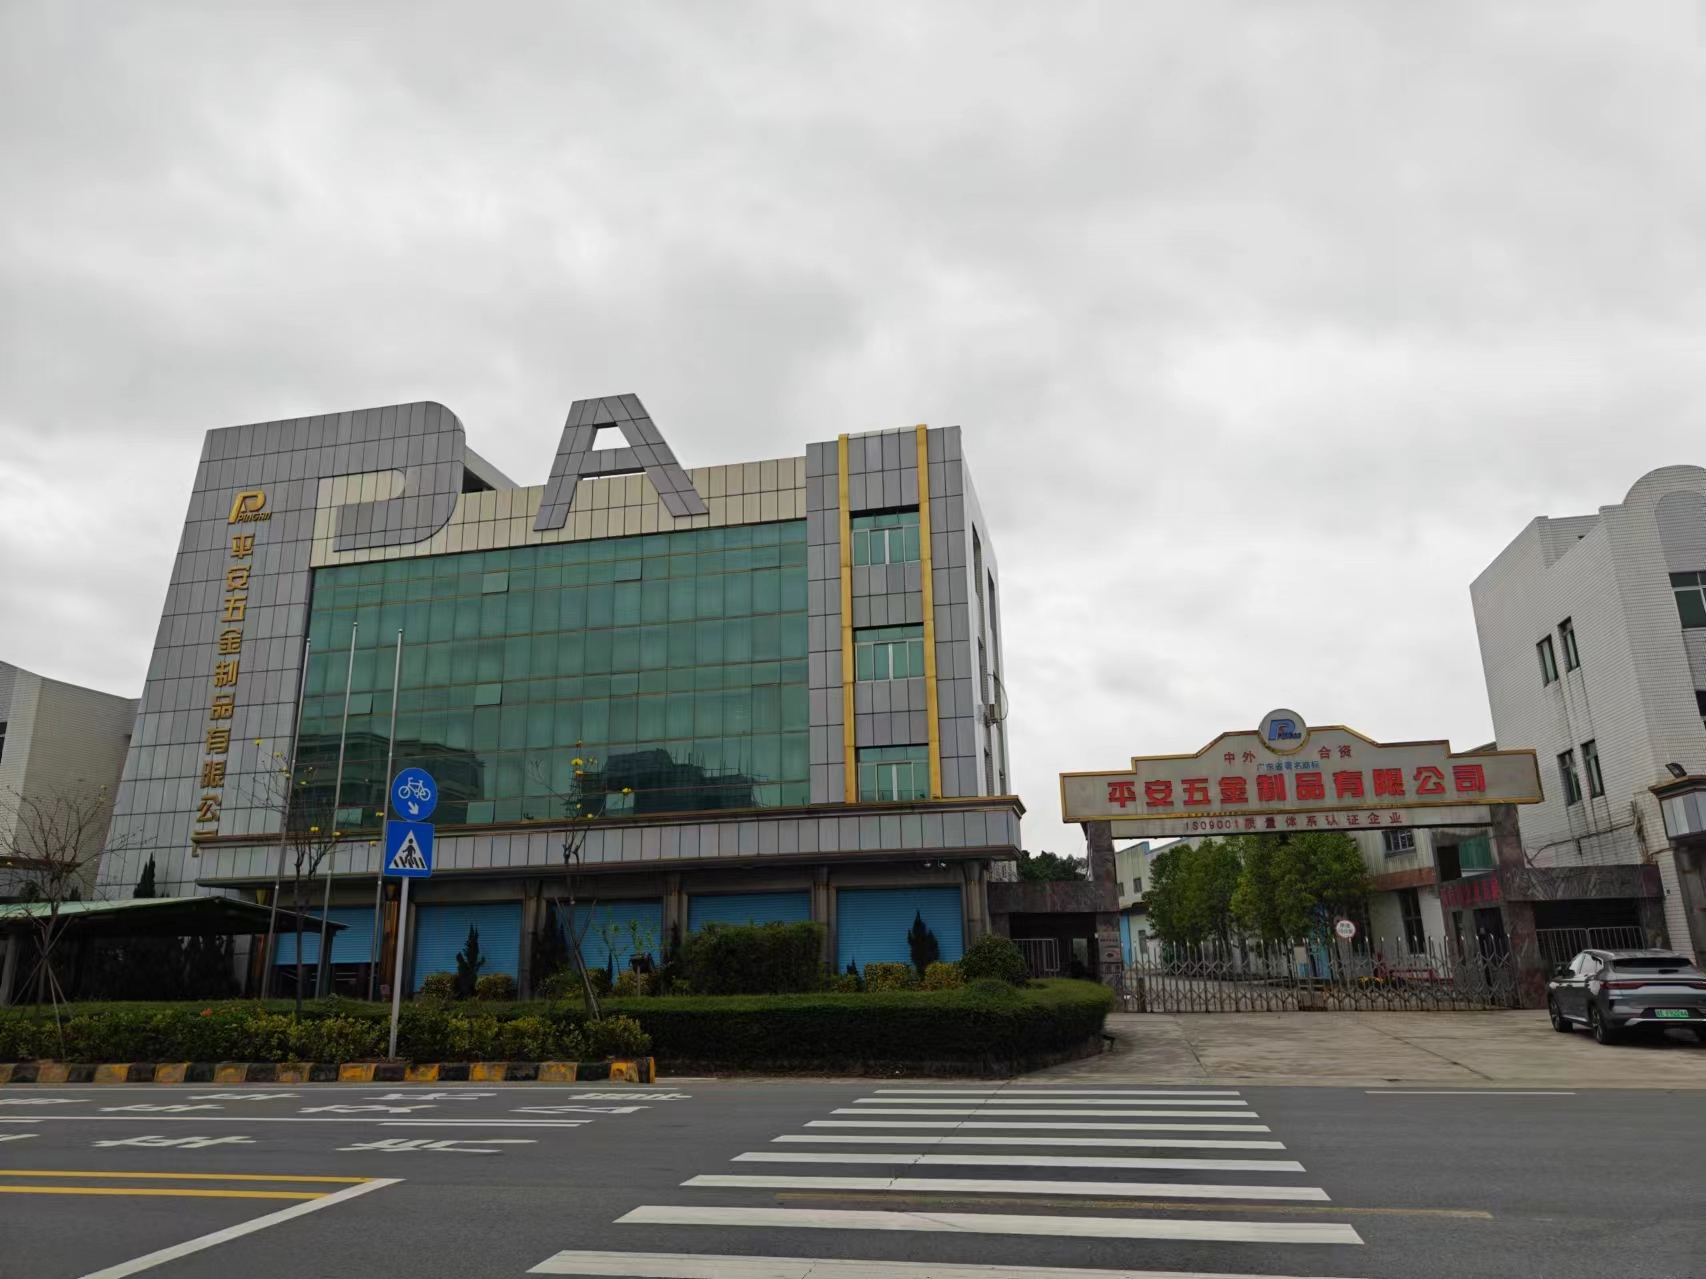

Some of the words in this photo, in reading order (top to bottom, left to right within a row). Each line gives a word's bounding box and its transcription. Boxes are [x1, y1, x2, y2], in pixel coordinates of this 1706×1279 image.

[1107, 764, 1486, 808] 平安五金制品有限公司
